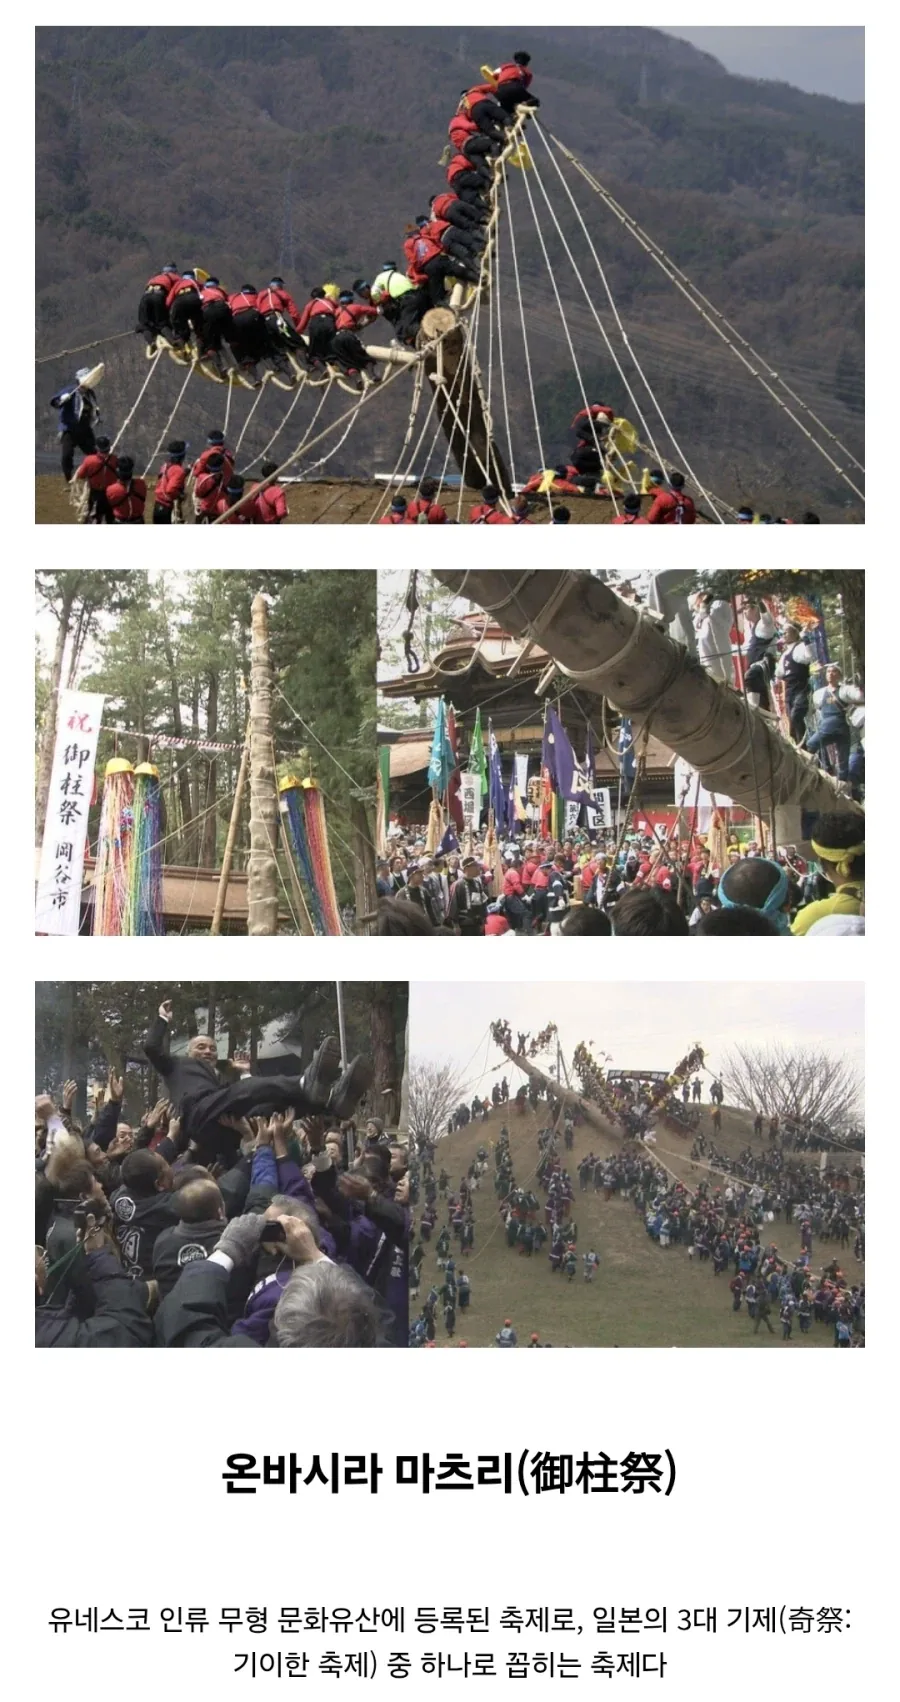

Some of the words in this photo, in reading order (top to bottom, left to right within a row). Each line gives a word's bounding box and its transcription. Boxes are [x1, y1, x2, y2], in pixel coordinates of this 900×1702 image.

[66, 709, 93, 734] 祝
[57, 743, 90, 825] 御柱祭
[52, 840, 73, 909] 岡谷市
